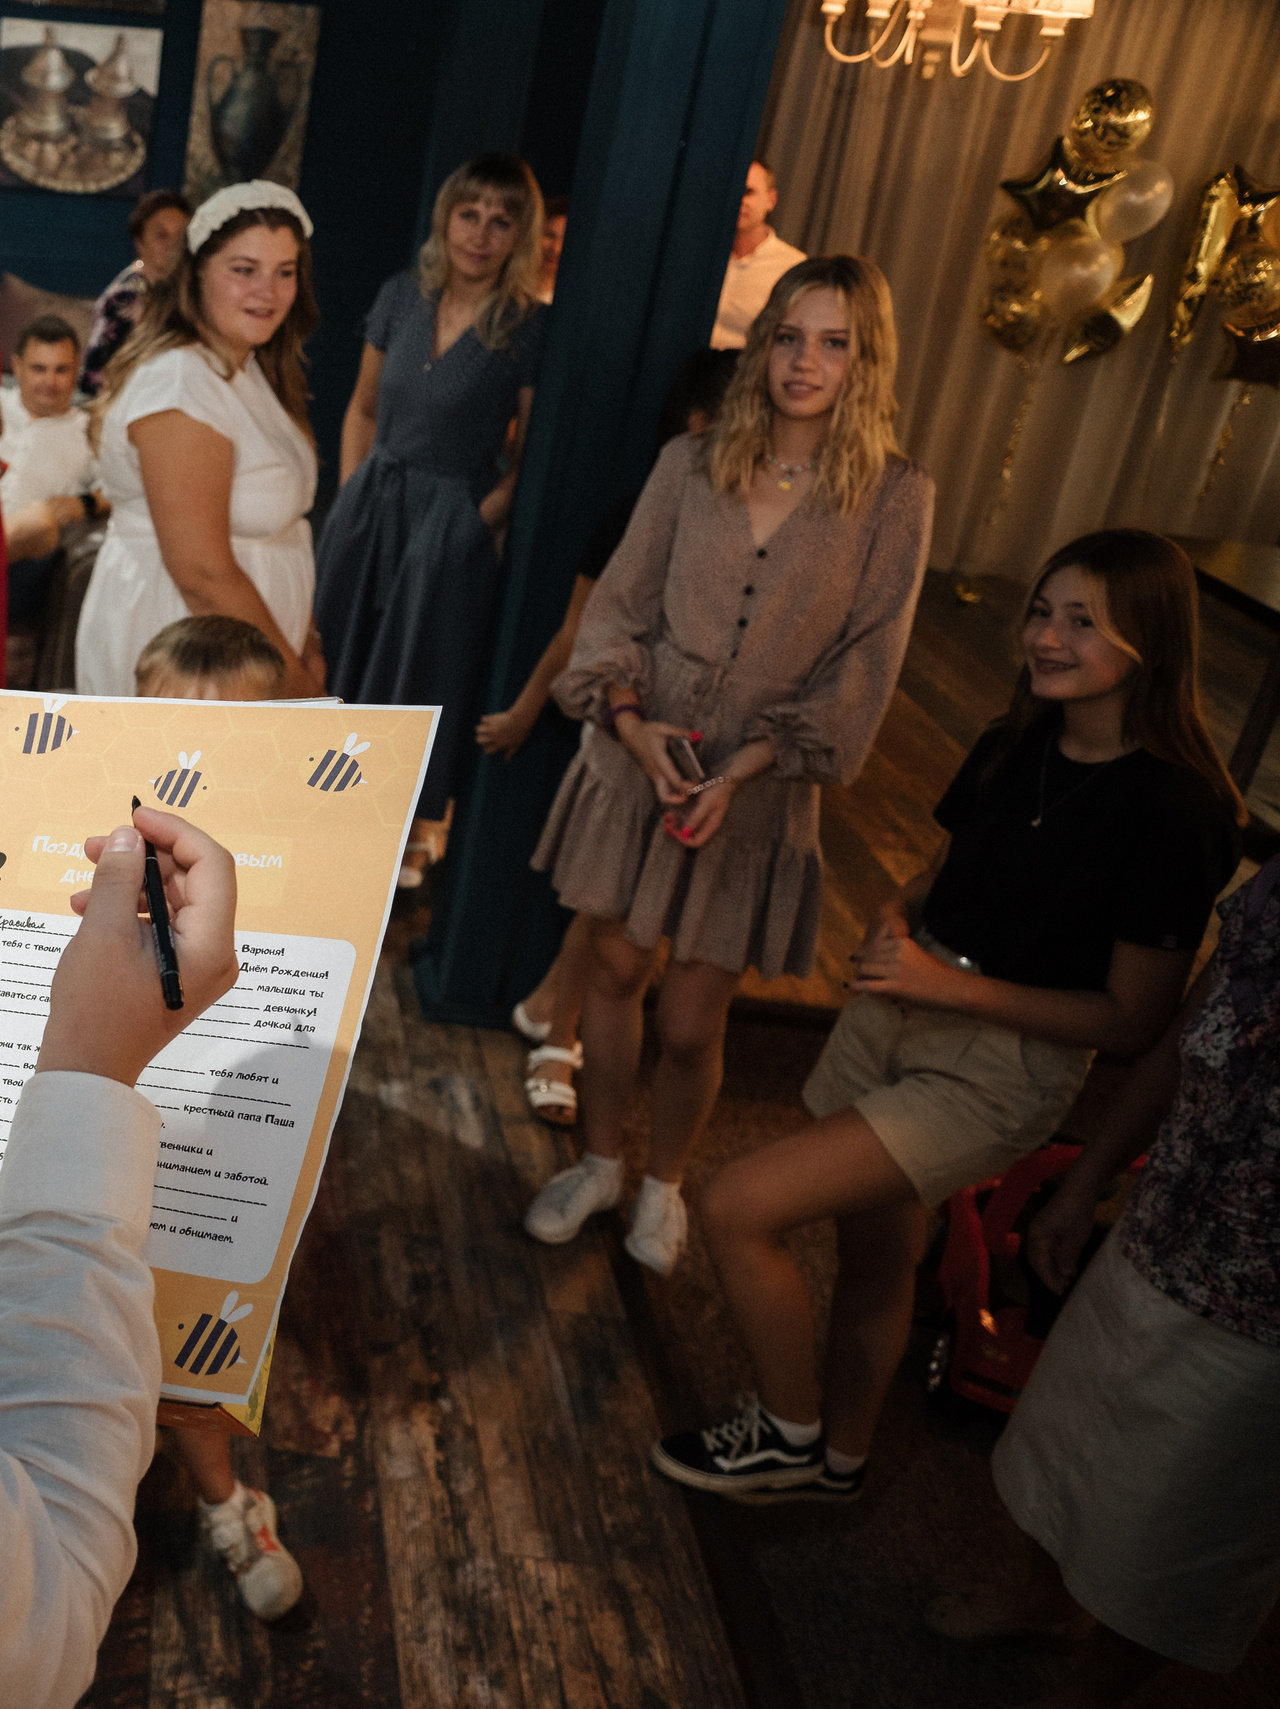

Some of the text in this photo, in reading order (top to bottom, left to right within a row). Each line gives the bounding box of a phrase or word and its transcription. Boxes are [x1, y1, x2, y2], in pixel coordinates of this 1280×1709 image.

[232, 853, 282, 868] вым
[59, 868, 95, 884] дне
[241, 944, 285, 957] Варюня!
[1, 939, 23, 949] тебя
[33, 944, 62, 954] твоим
[239, 962, 268, 973] Днём
[270, 965, 329, 980] Рождения!
[256, 984, 306, 996] малышки
[309, 989, 325, 998] ты
[39, 995, 51, 1003] са
[253, 1019, 291, 1030] дочкой
[294, 1023, 316, 1033] для
[263, 1004, 317, 1018] девчонку!
[17, 1043, 32, 1051] так
[209, 1069, 234, 1079] тебя
[235, 1071, 269, 1083] любят
[271, 1076, 279, 1085] и
[2, 1077, 24, 1087] твой
[183, 1104, 234, 1118] крестный
[237, 1112, 262, 1122] папа
[264, 1113, 295, 1128] Паша
[159, 1141, 204, 1155] венники
[206, 1148, 214, 1156] и
[214, 1170, 221, 1178] и
[224, 1172, 269, 1185] заботой.
[231, 1215, 238, 1223] и
[169, 1226, 177, 1234] и
[179, 1227, 234, 1244] обнимаем.
